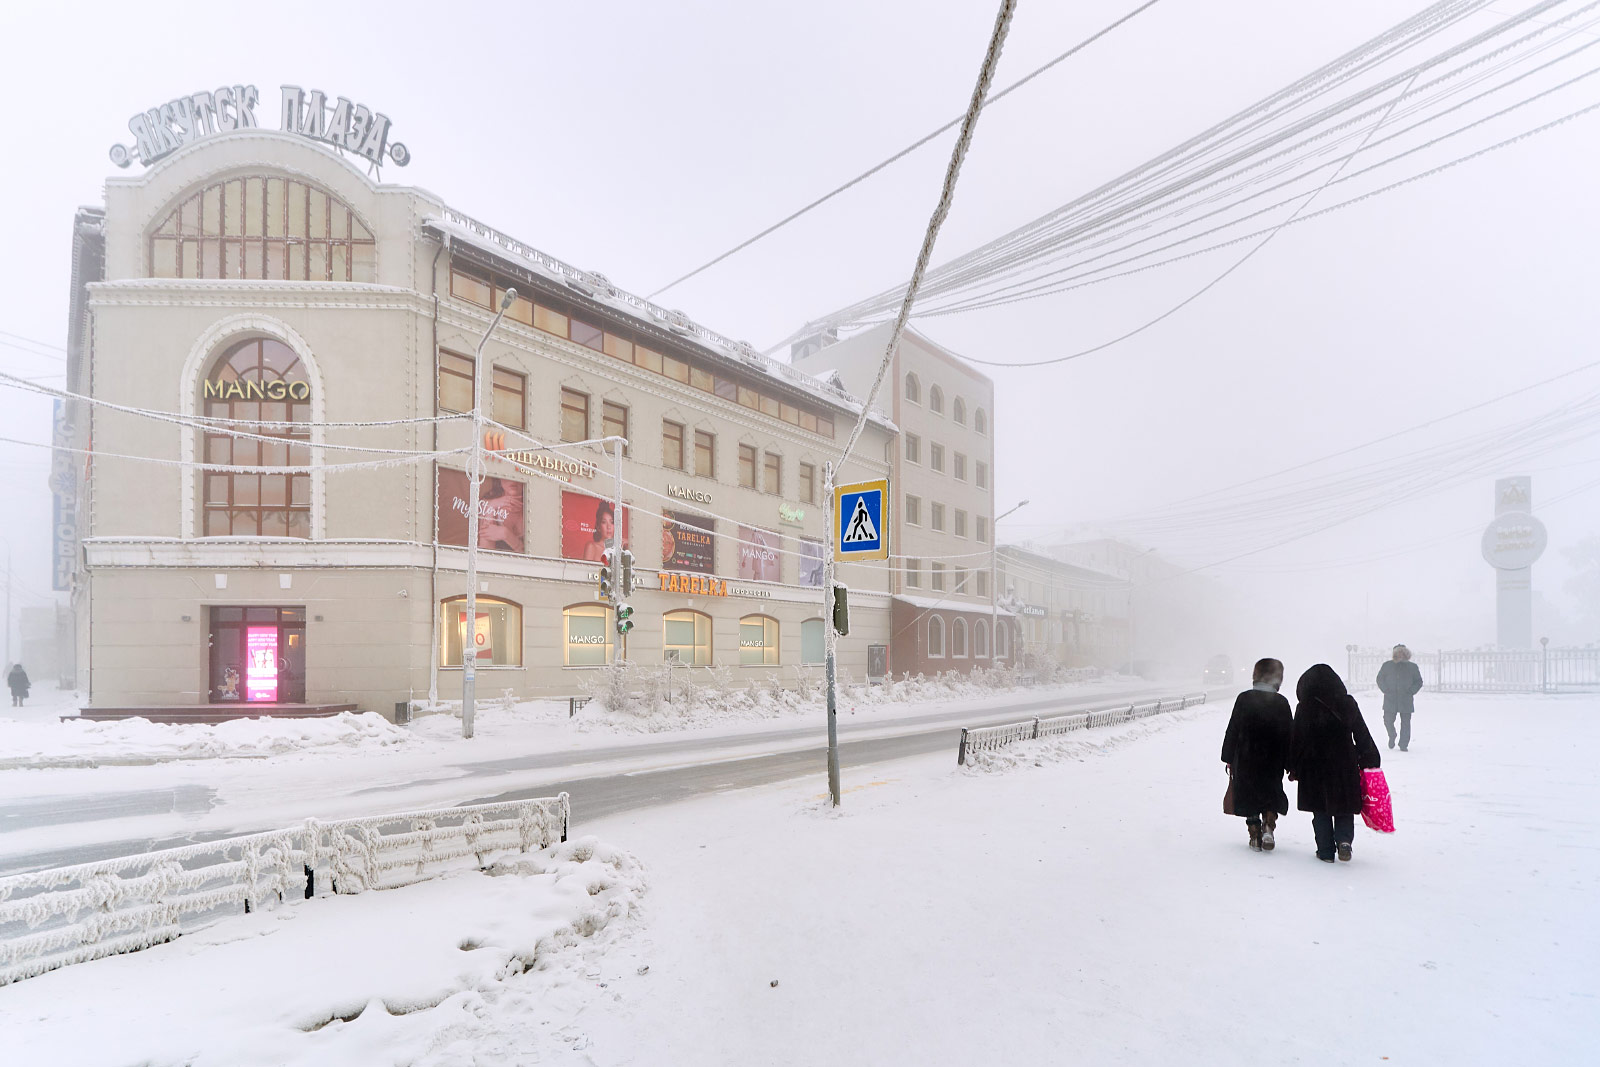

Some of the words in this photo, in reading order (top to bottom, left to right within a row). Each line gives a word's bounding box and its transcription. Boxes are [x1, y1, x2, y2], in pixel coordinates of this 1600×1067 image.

[128, 85, 260, 168] ЯКУТСК
[280, 85, 391, 169] ПЛАЗА
[204, 379, 310, 400] MANGO
[667, 483, 713, 504] MANGO
[677, 531, 711, 545] TARELKA
[742, 547, 775, 561] MANGO
[658, 572, 728, 597] TARELKA
[570, 635, 605, 644] MANGO
